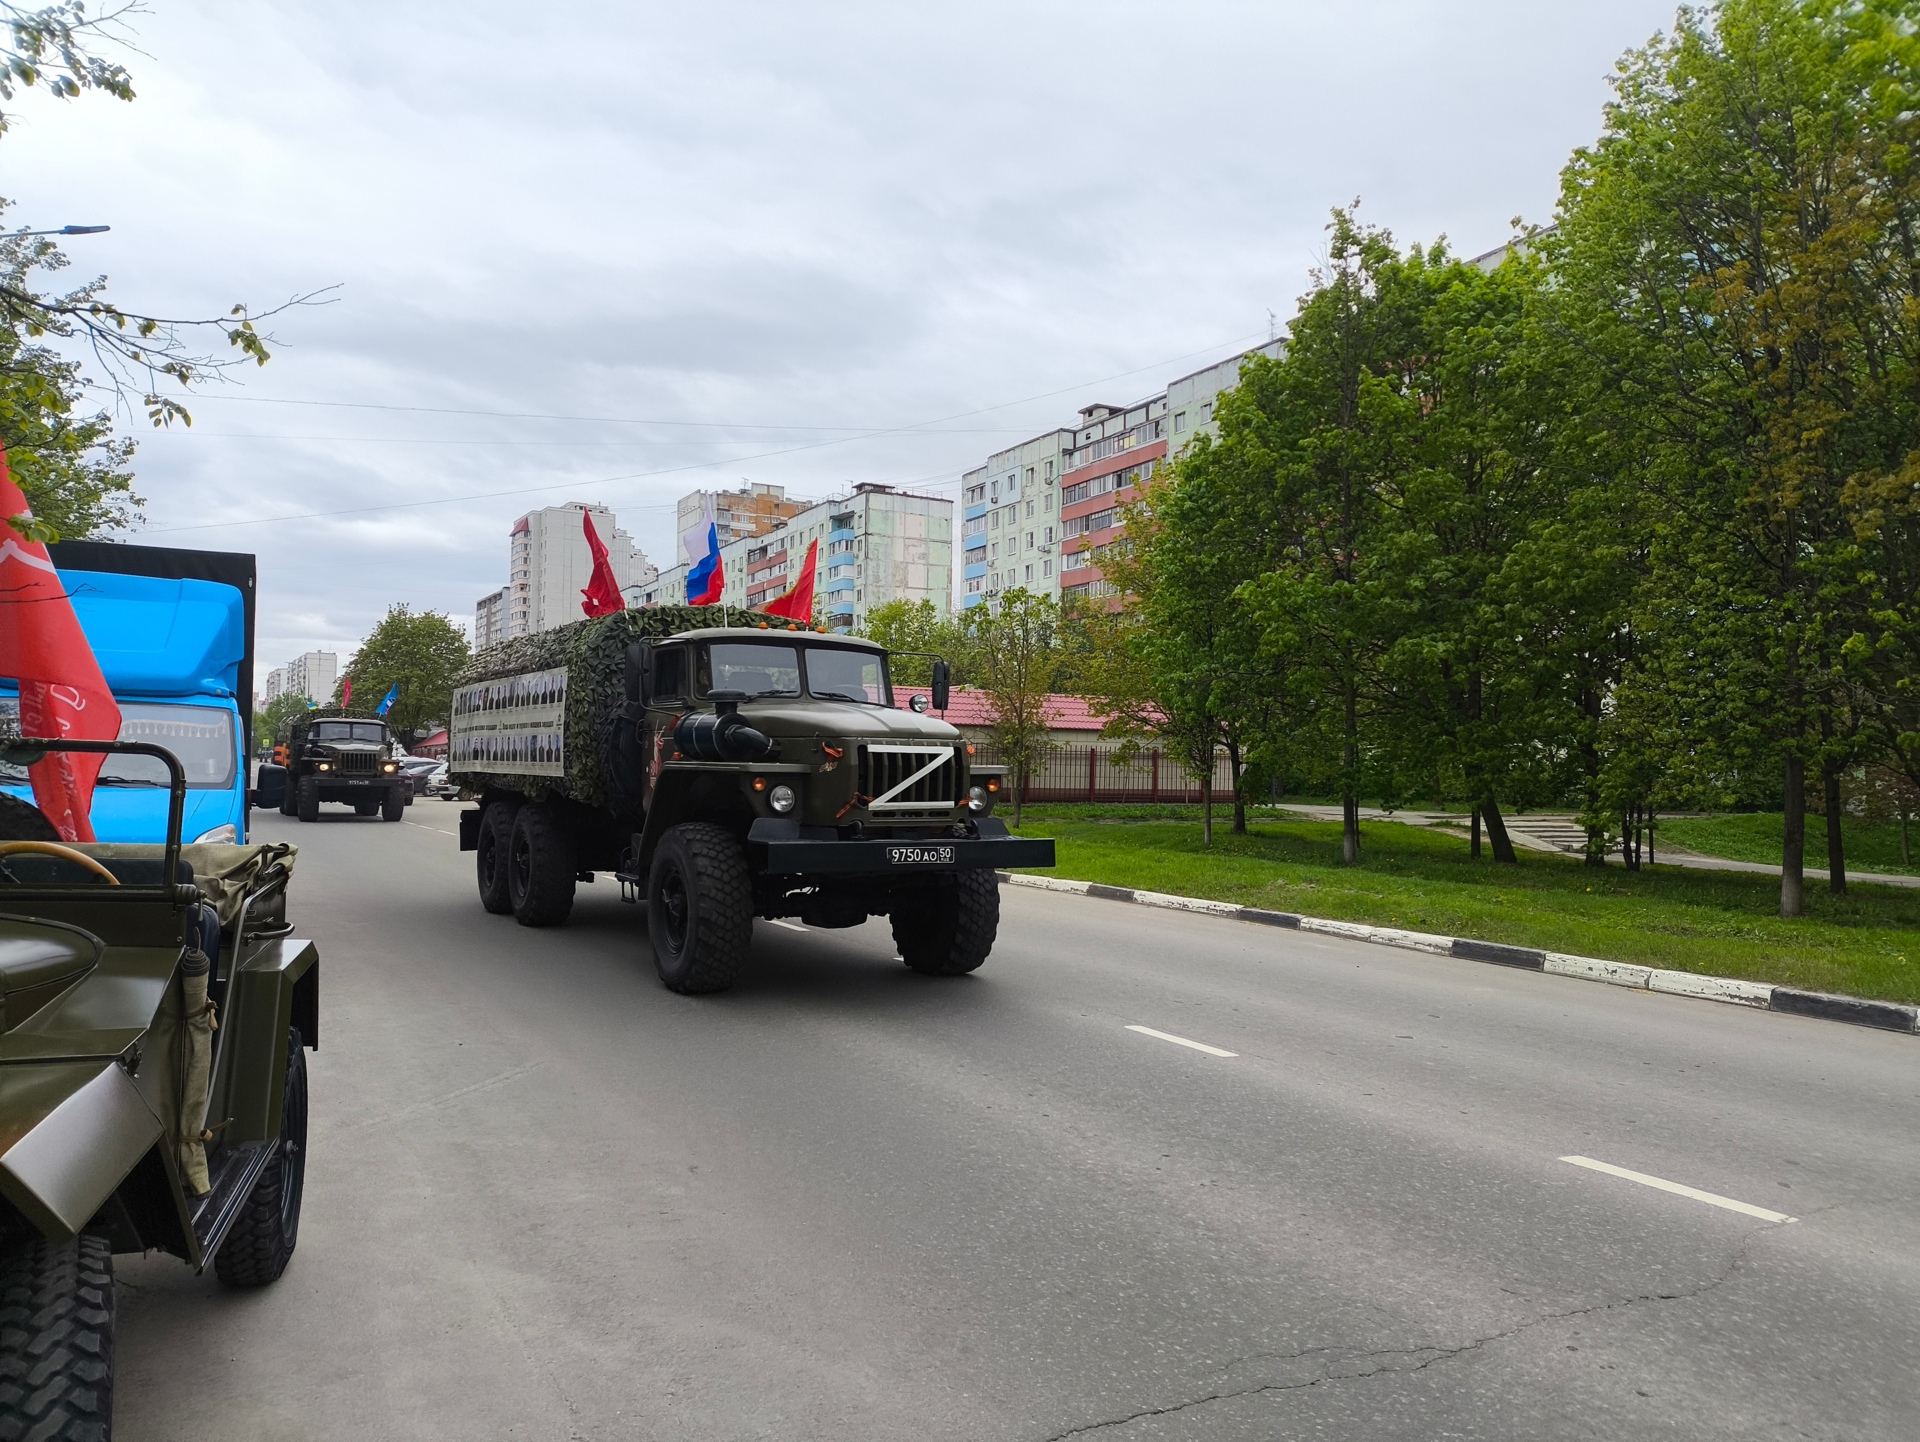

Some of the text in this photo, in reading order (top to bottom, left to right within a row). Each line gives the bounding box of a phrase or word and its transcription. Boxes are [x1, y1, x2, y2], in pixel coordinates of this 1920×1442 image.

[867, 744, 955, 811] Z
[892, 848, 921, 862] 9750
[939, 848, 951, 858] 50
